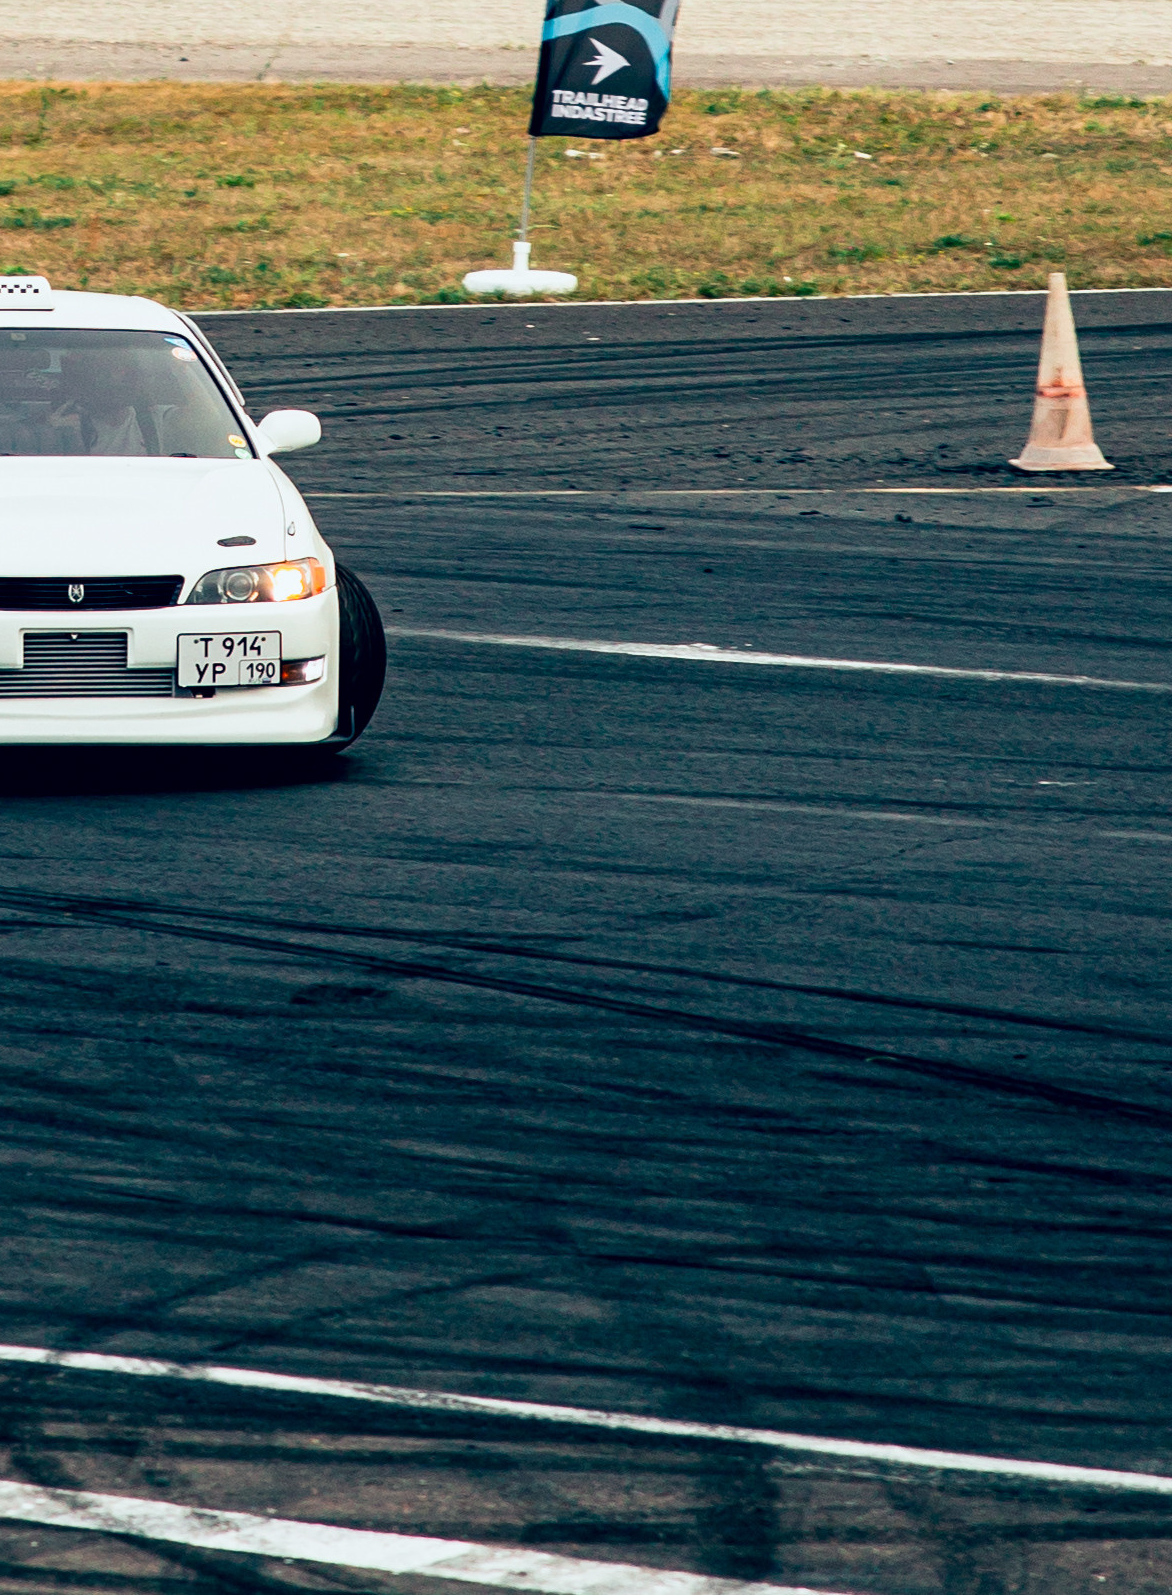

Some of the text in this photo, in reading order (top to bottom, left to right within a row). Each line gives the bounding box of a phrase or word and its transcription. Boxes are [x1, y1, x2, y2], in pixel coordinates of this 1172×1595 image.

[551, 89, 649, 111] TRAILHEAD
[551, 103, 647, 125] INDASTREE
[222, 636, 261, 657] 914
[246, 661, 276, 679] 190
